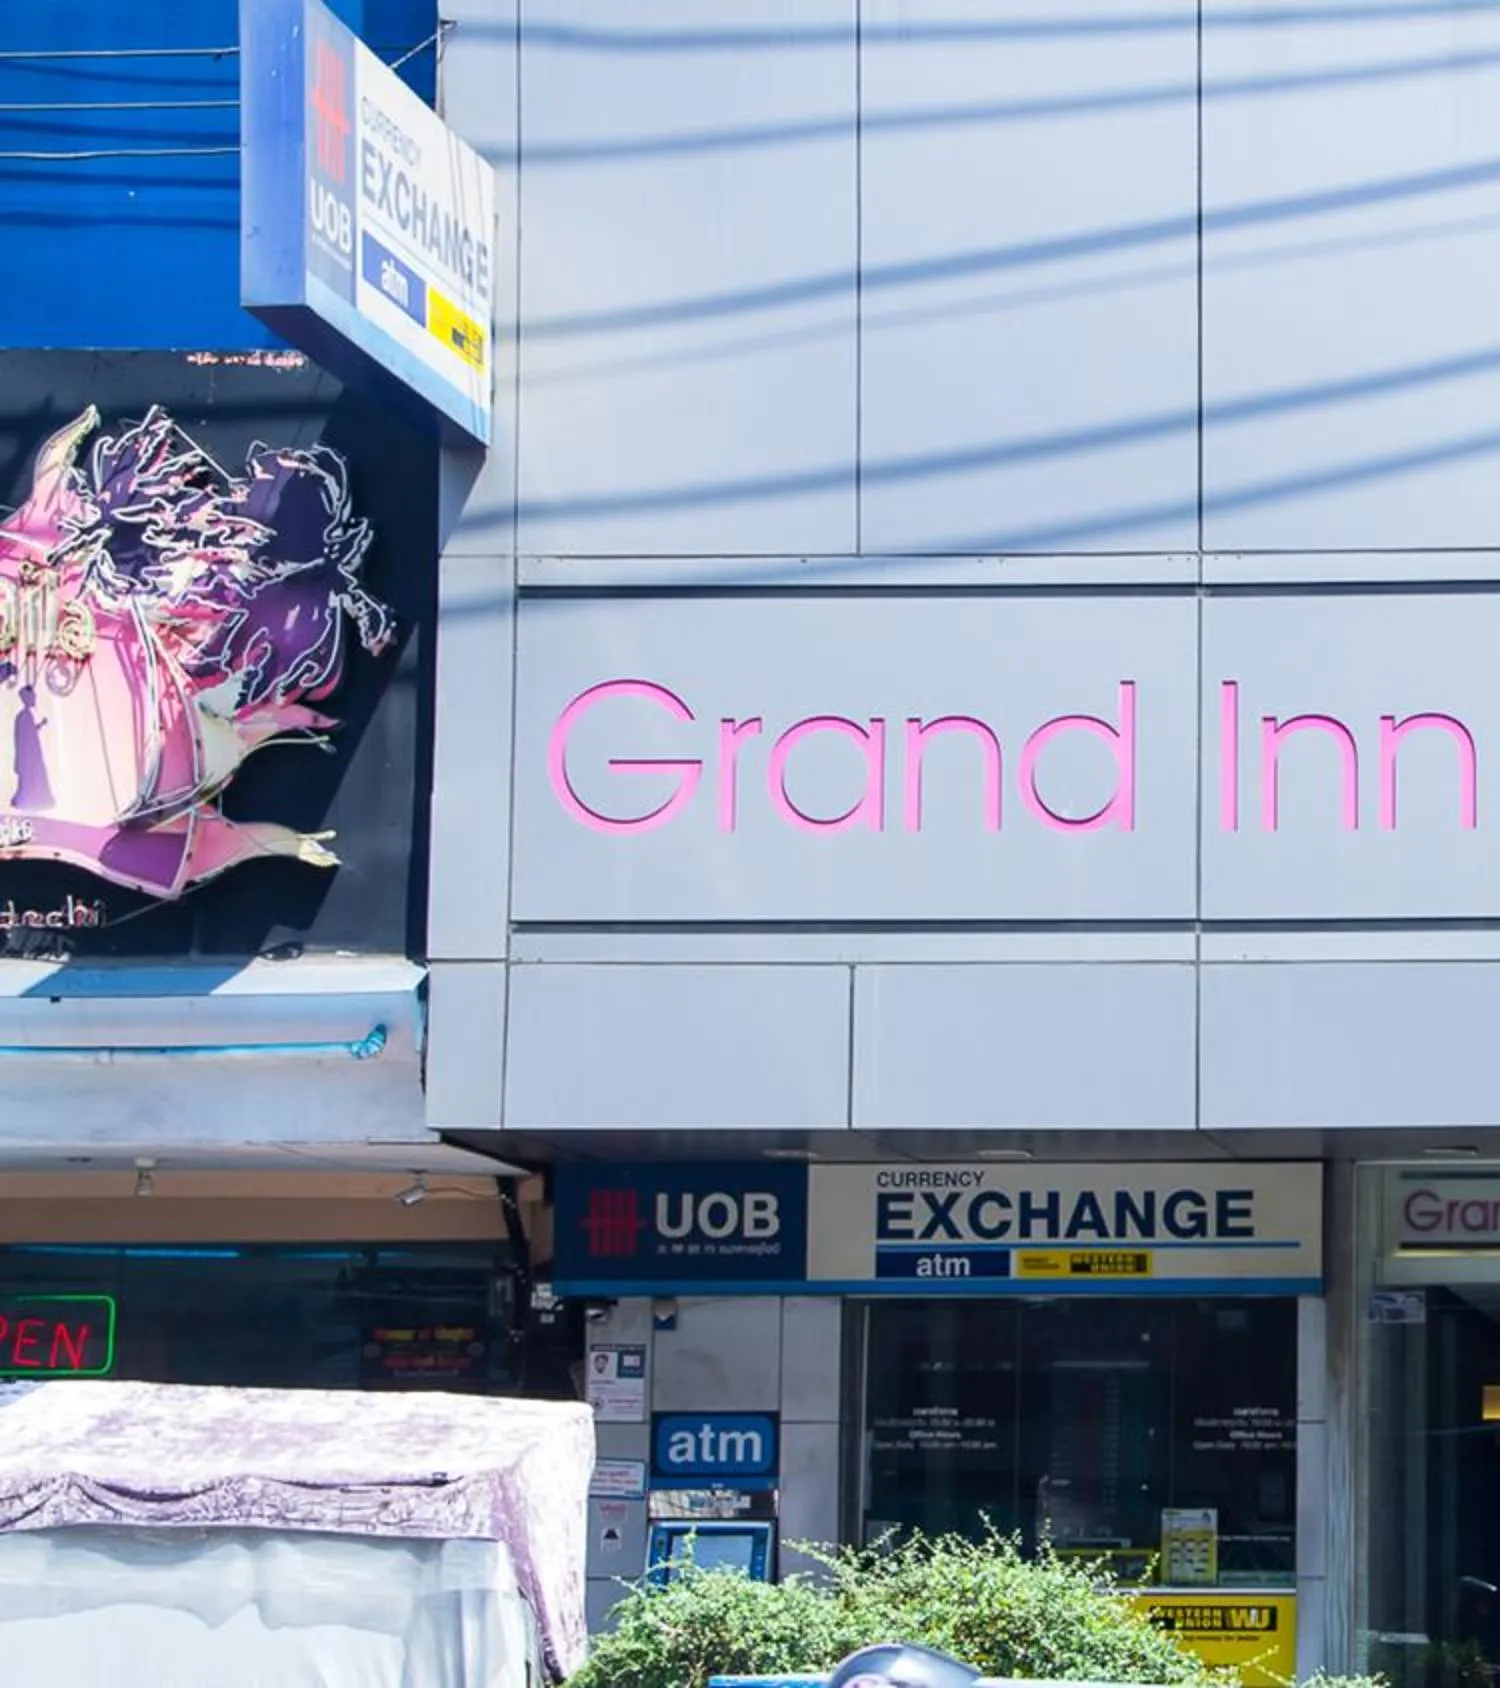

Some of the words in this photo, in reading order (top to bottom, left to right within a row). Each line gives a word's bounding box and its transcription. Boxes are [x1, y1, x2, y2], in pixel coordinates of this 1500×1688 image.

[310, 181, 352, 253] UOB
[361, 137, 489, 298] EXCHANGE
[380, 257, 409, 308] atm
[547, 679, 1136, 836] Grand
[1220, 679, 1477, 832] Inn
[876, 1171, 985, 1188] CURRENCY
[656, 1192, 781, 1239] UOB
[876, 1189, 1254, 1240] EXCHANGE
[915, 1253, 971, 1278] atm
[667, 1423, 763, 1464] atm
[1230, 1607, 1271, 1628] WU
